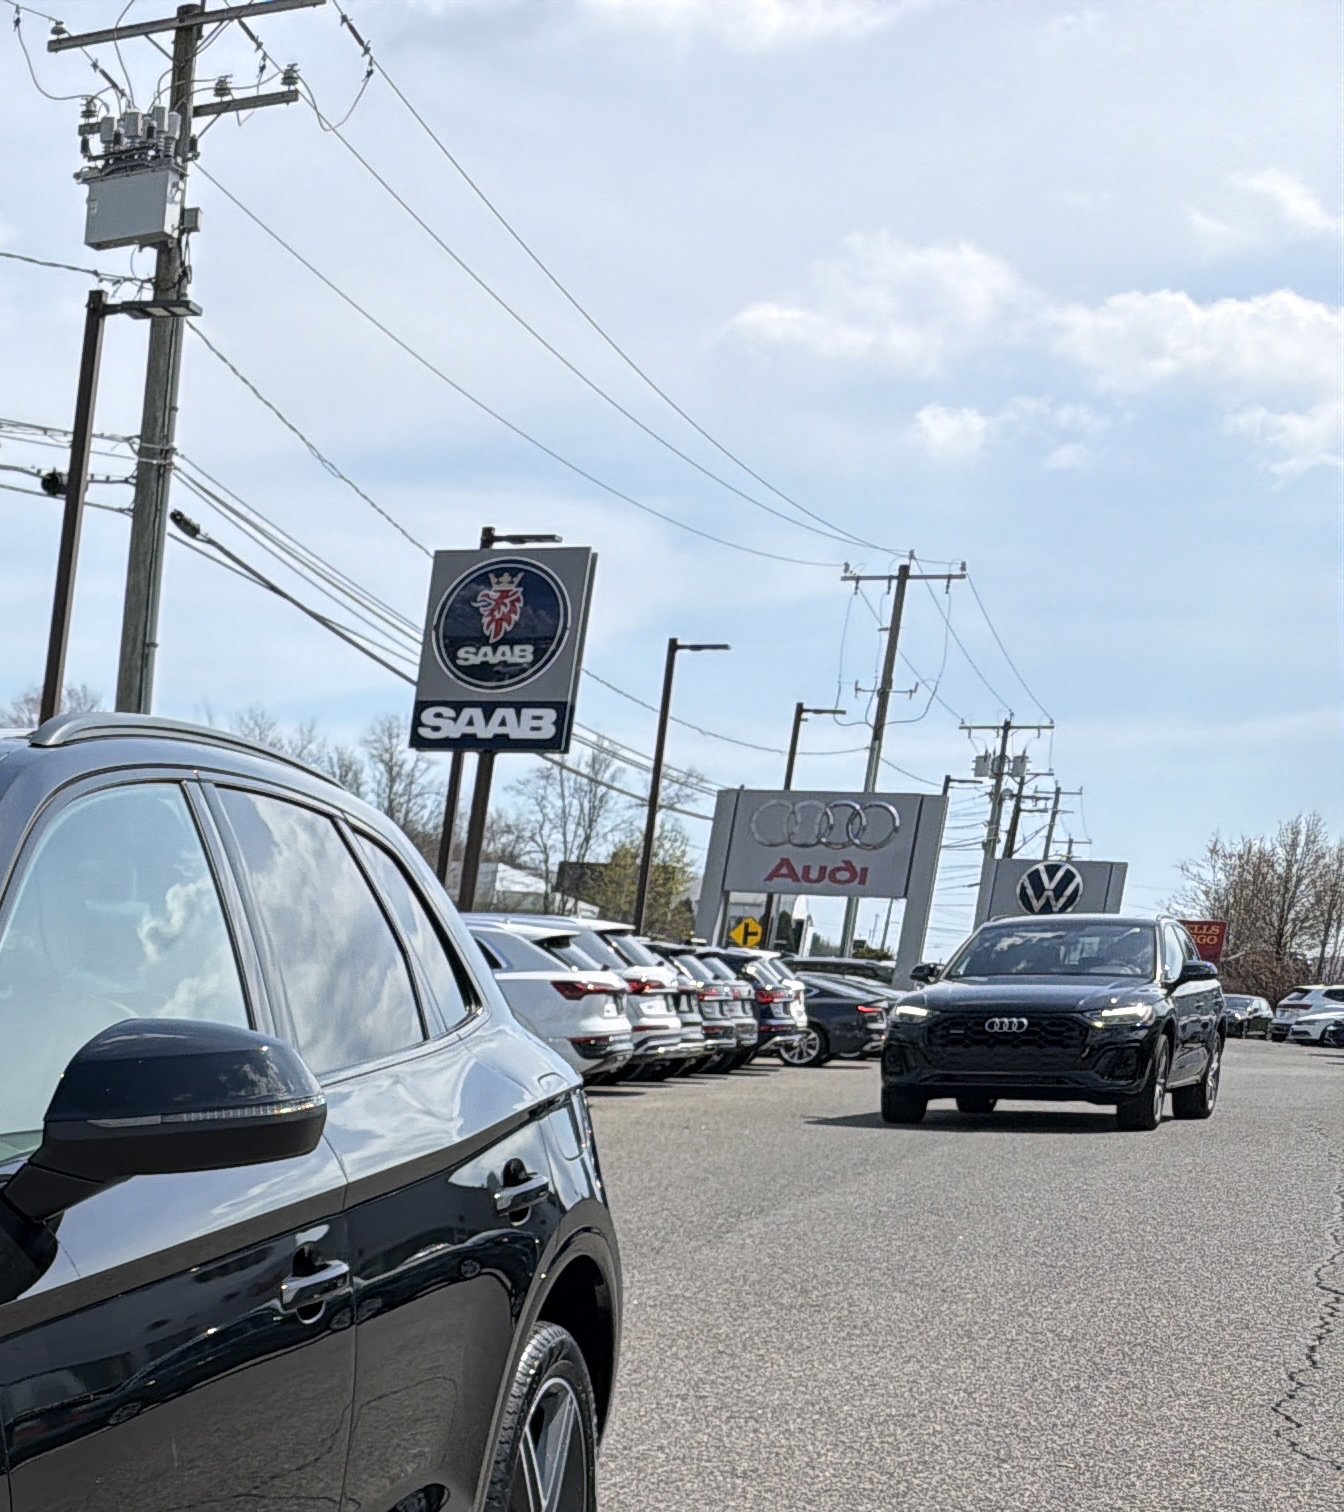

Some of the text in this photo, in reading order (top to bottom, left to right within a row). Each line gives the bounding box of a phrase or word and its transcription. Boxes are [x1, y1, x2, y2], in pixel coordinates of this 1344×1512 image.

[456, 644, 535, 666] SAAB
[417, 706, 557, 740] SAAB
[764, 857, 869, 885] Audi
